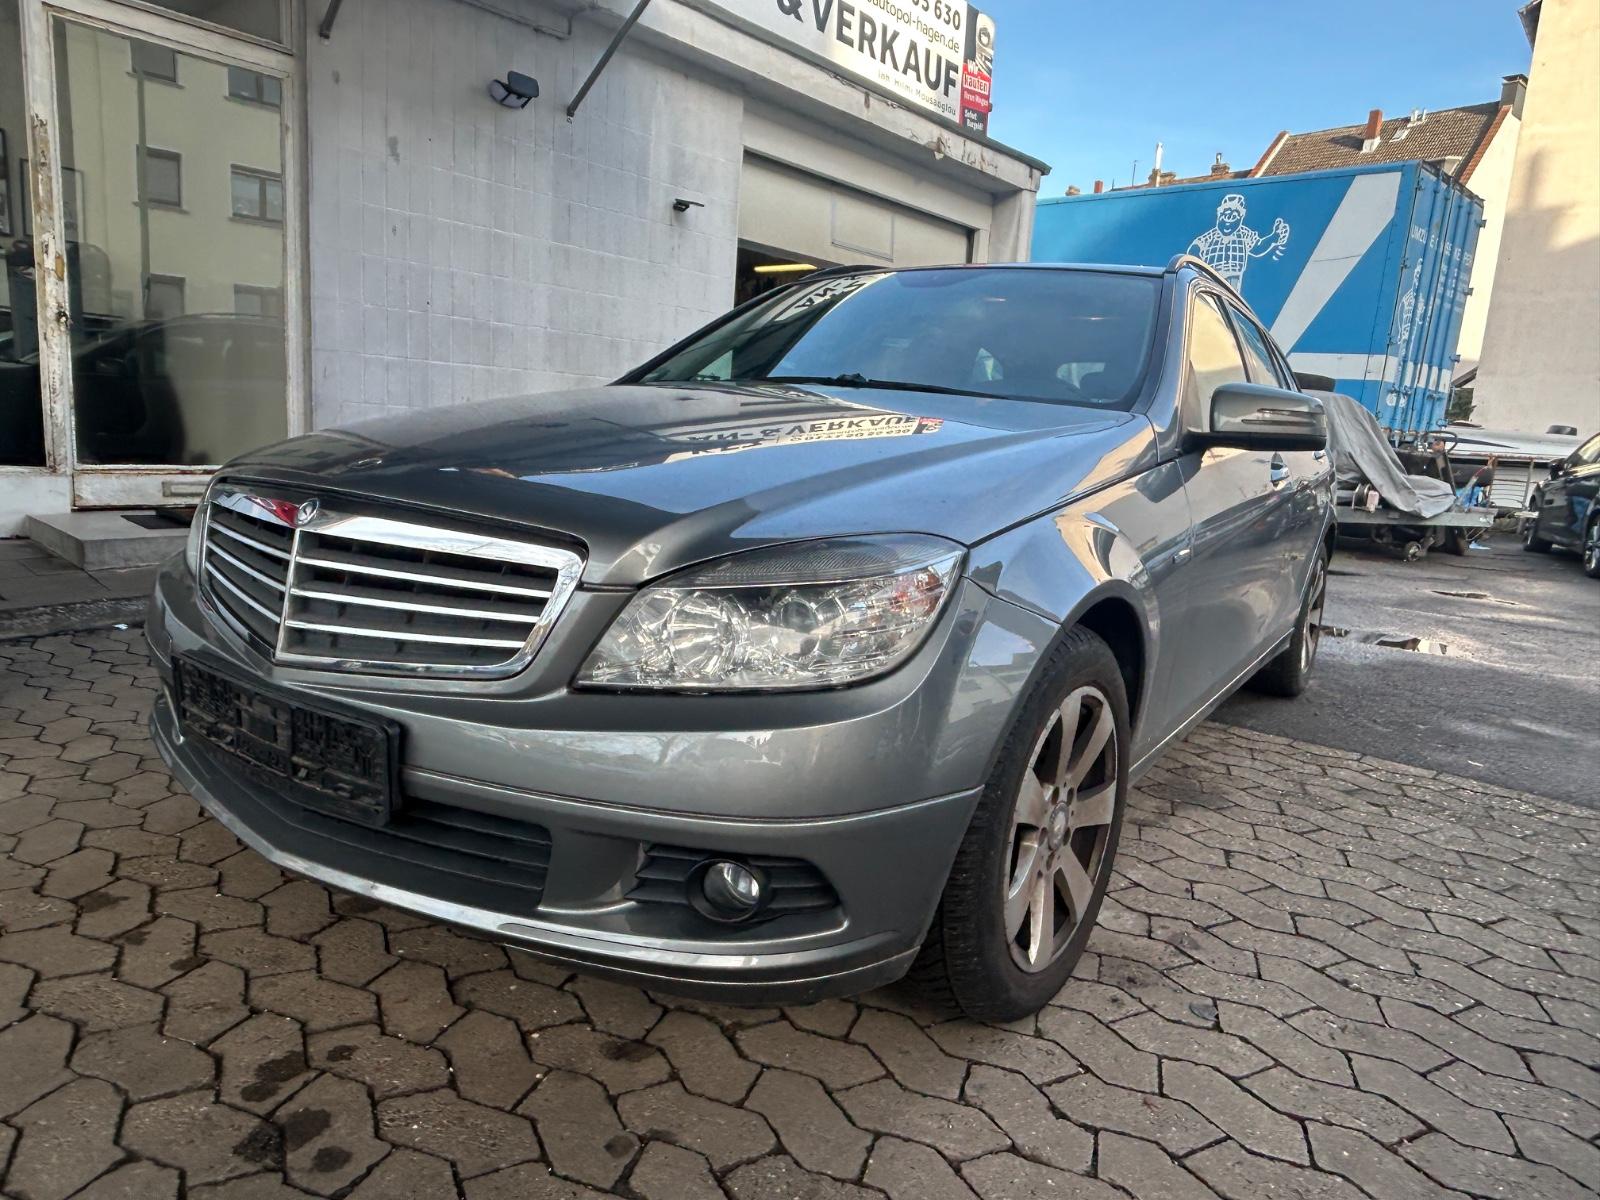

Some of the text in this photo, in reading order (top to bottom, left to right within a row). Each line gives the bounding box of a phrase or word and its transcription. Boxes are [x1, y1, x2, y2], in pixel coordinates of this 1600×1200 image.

[866, 0, 960, 53] autopol-hagen.de
[934, 0, 961, 31] 630
[812, 0, 959, 98] VERKAUF
